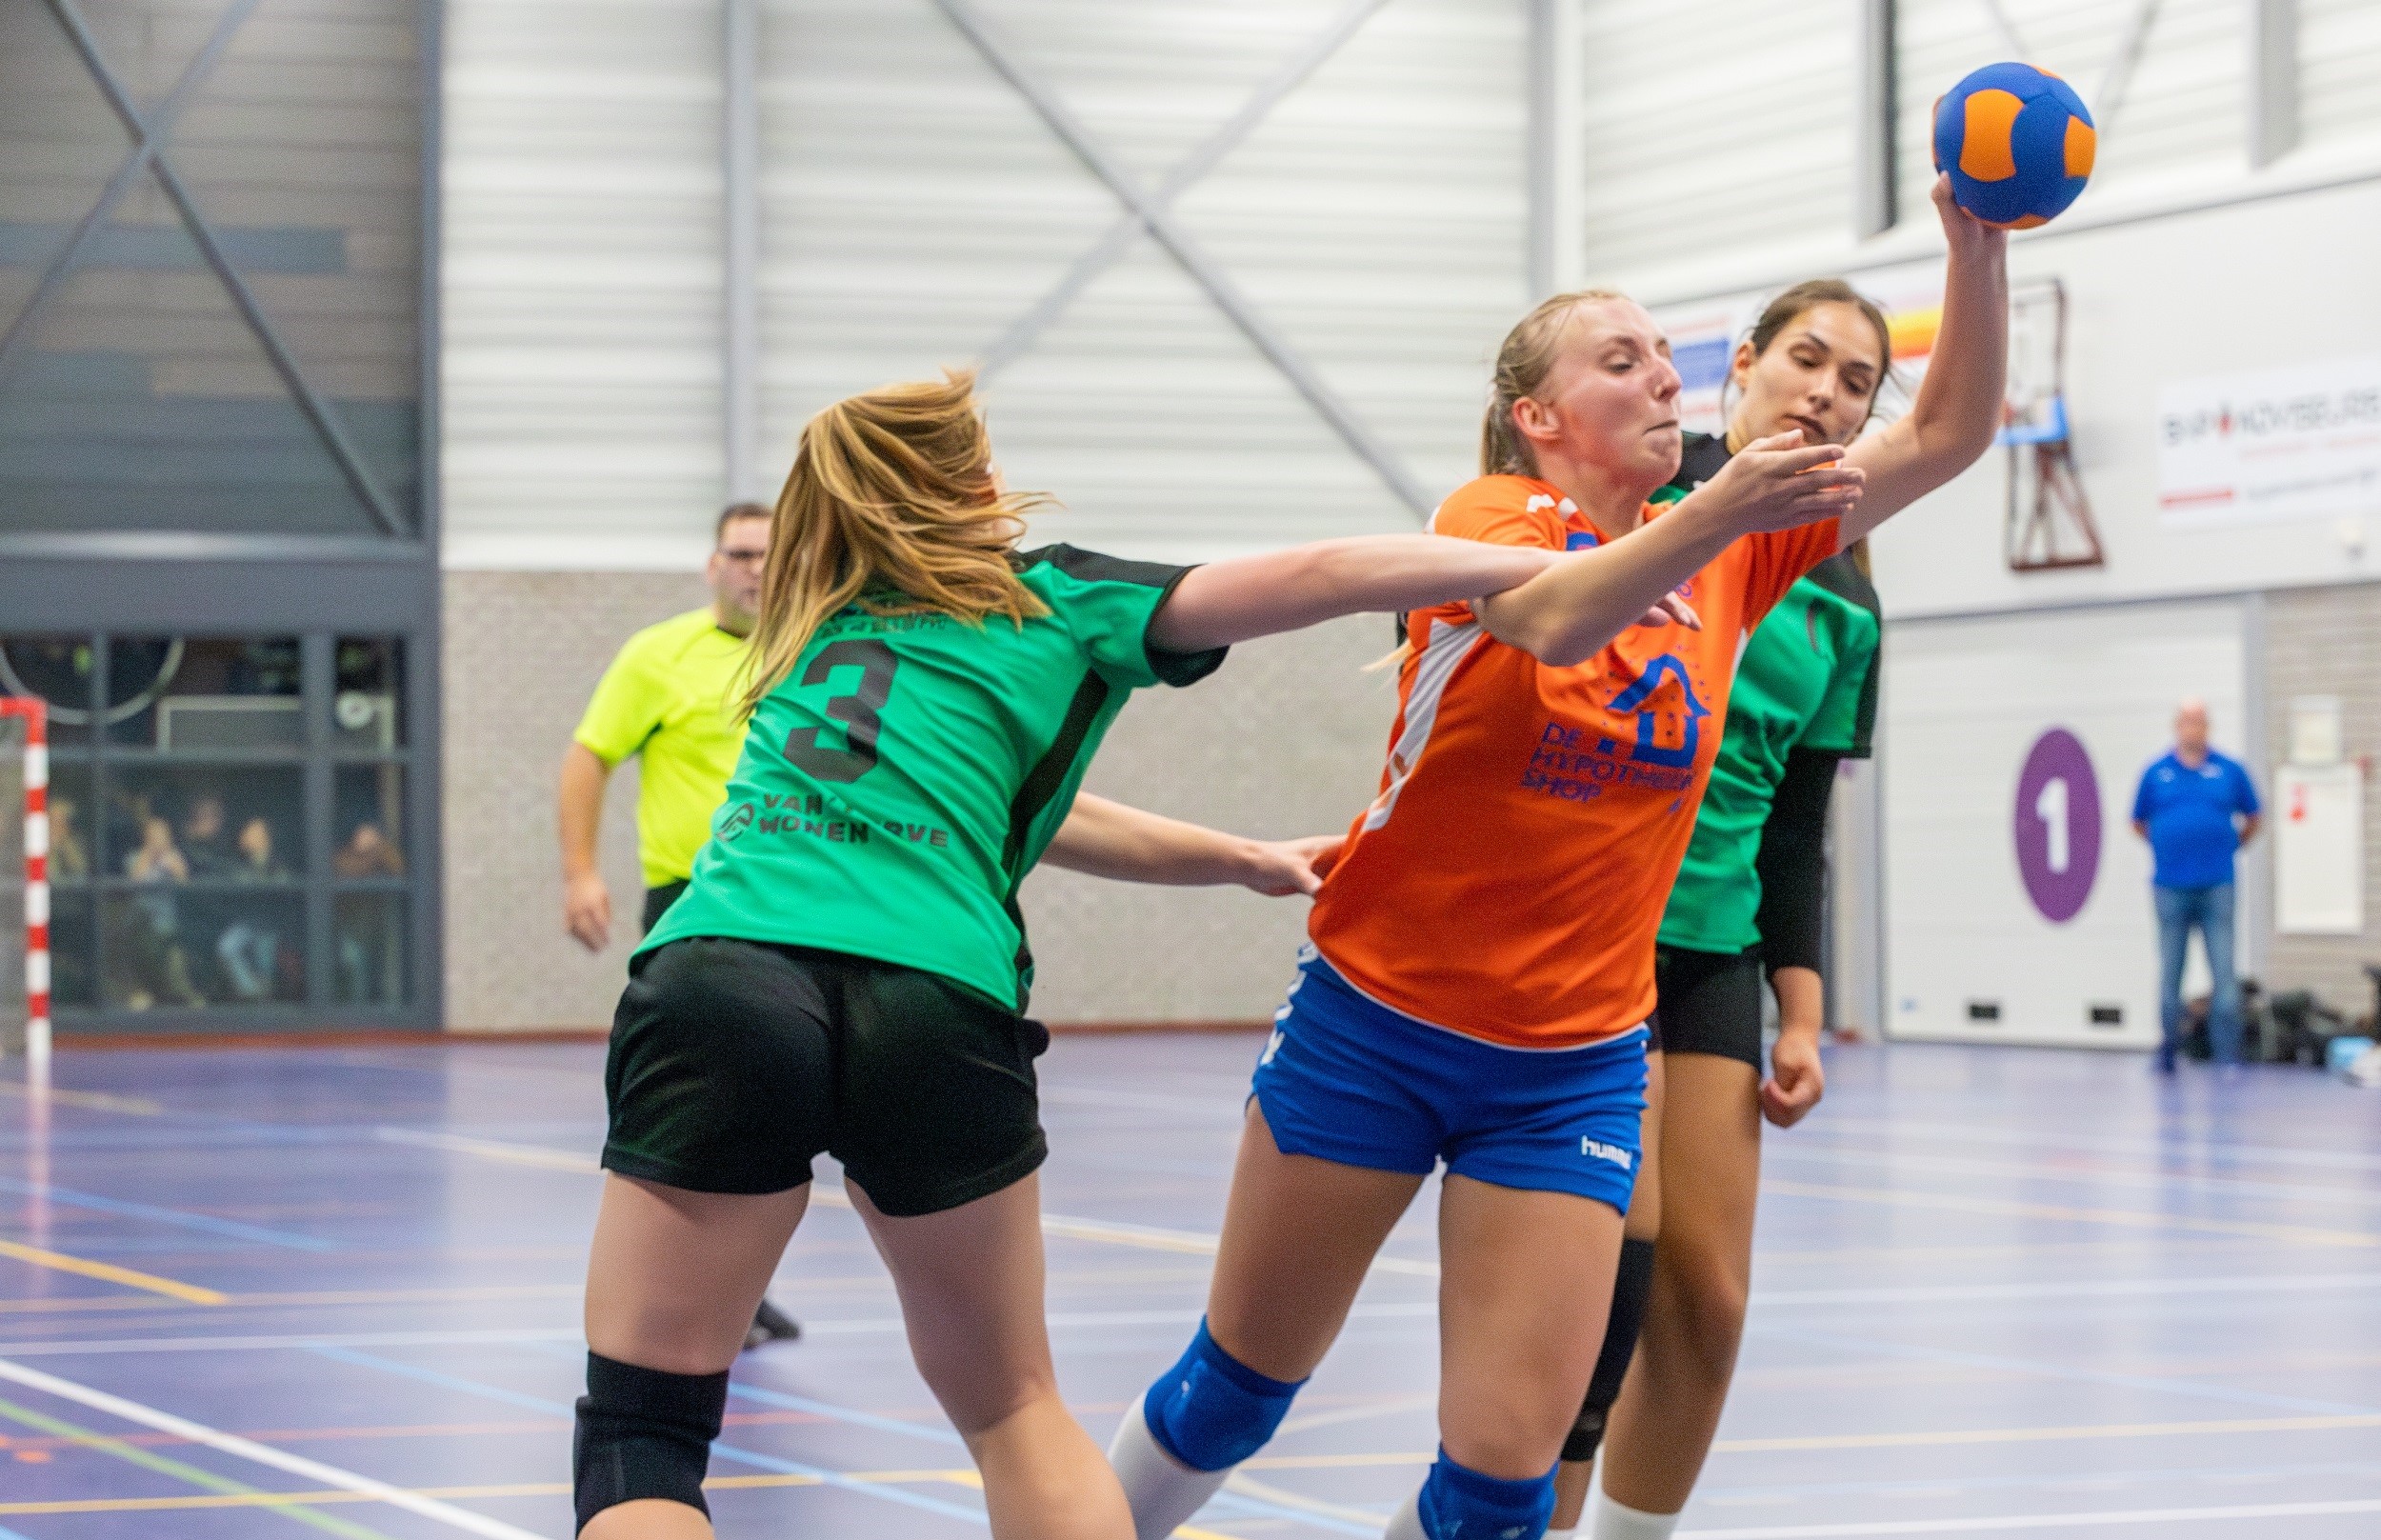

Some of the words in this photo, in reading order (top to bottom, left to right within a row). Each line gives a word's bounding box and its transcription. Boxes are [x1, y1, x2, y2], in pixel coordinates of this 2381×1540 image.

[784, 639, 898, 784] 3
[1542, 722, 1582, 750] DE
[763, 792, 824, 816] VAN
[2034, 776, 2071, 874] 1
